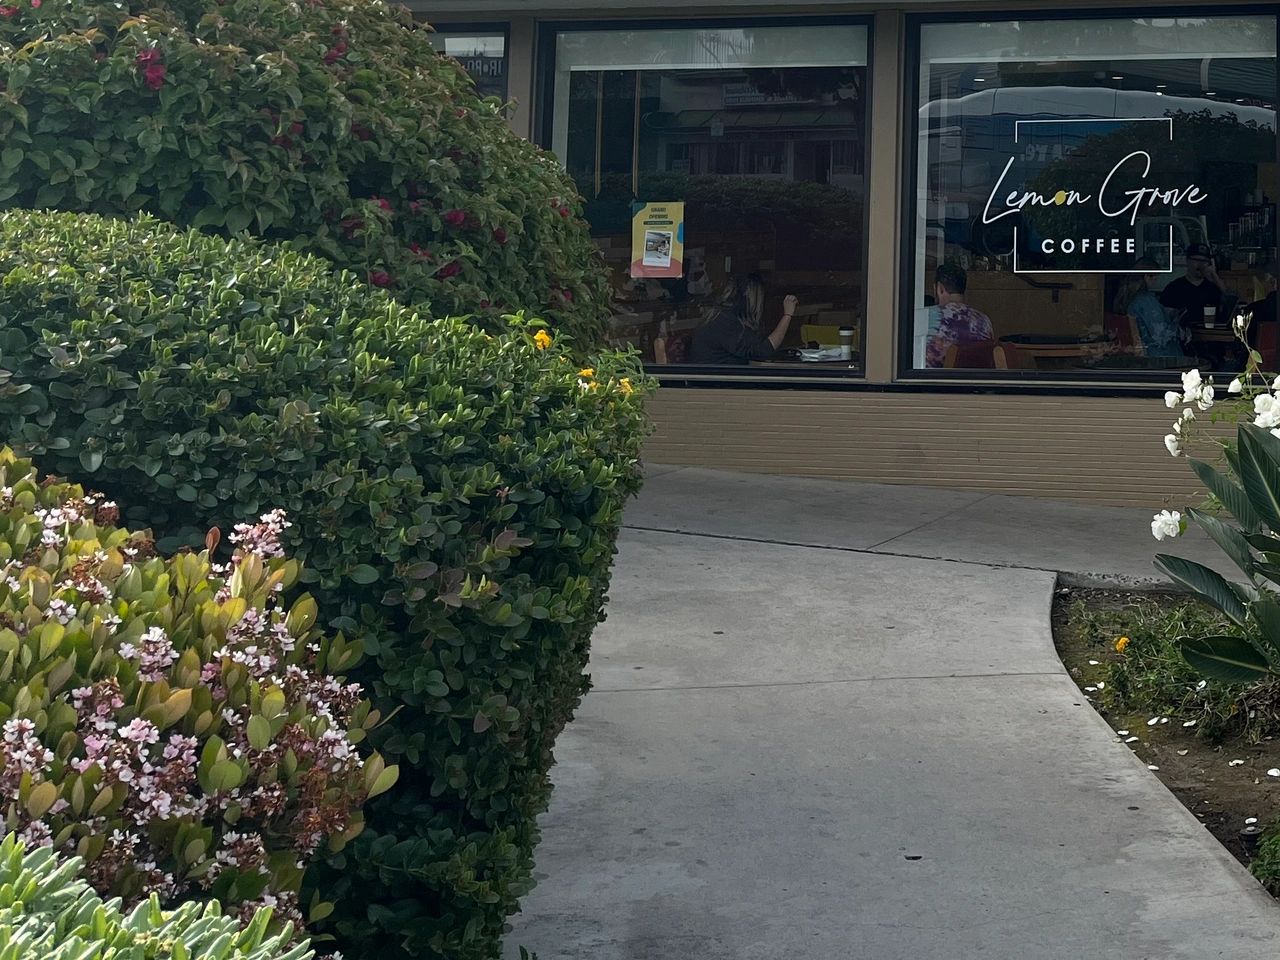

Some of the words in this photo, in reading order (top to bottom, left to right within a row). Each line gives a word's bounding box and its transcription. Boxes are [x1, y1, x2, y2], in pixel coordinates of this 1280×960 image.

[981, 155, 1092, 224] Lemon
[1098, 150, 1209, 227] Grove
[1041, 238, 1136, 254] COFFEE
